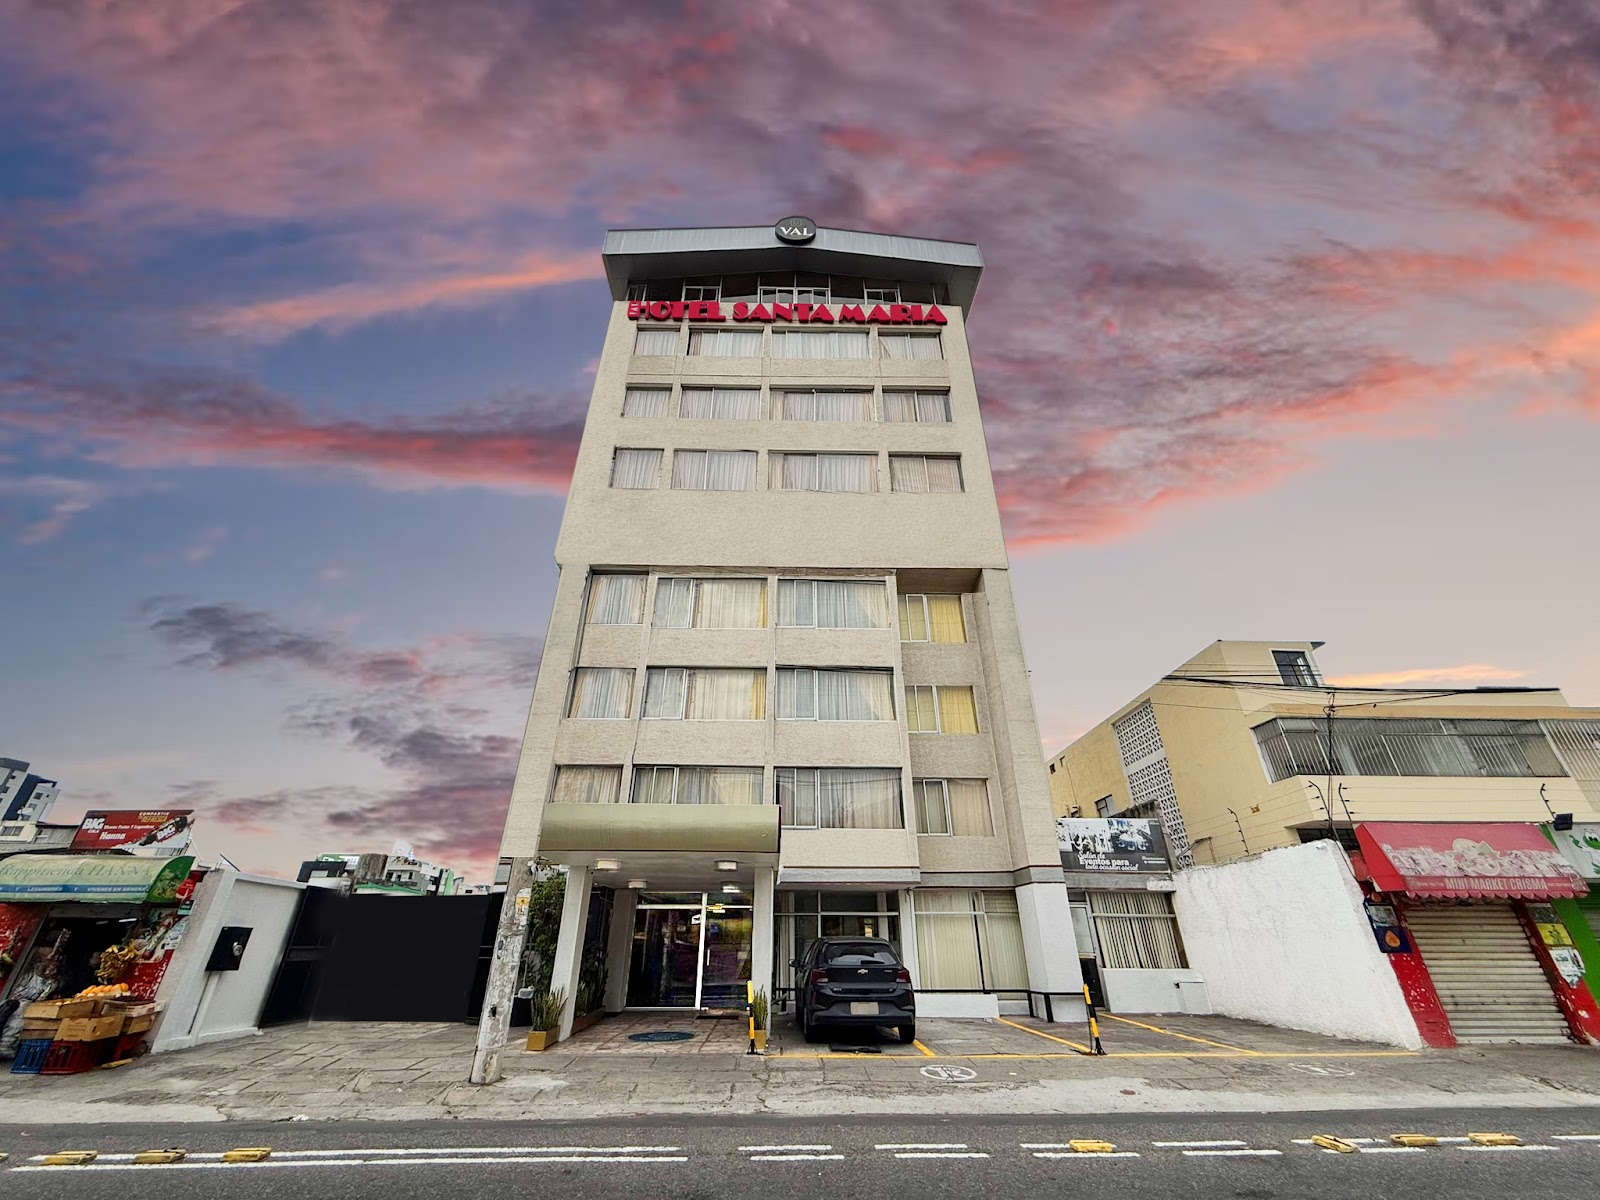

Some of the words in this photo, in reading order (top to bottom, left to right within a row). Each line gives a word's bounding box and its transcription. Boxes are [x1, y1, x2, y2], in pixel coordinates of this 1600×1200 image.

[780, 226, 813, 237] VAL
[627, 300, 726, 321] HOTEL
[733, 301, 834, 323] SANTA
[839, 303, 948, 325] MARIA
[82, 818, 105, 830] BIG
[99, 831, 126, 840] Hanna
[157, 825, 176, 840] BIG
[1097, 851, 1106, 859] de
[1079, 858, 1111, 866] Eventos
[1111, 859, 1130, 867] para
[1121, 863, 1139, 871] social
[1444, 877, 1467, 890] MINI
[1470, 878, 1508, 890] MARKET
[1510, 878, 1548, 890] CRISMA
